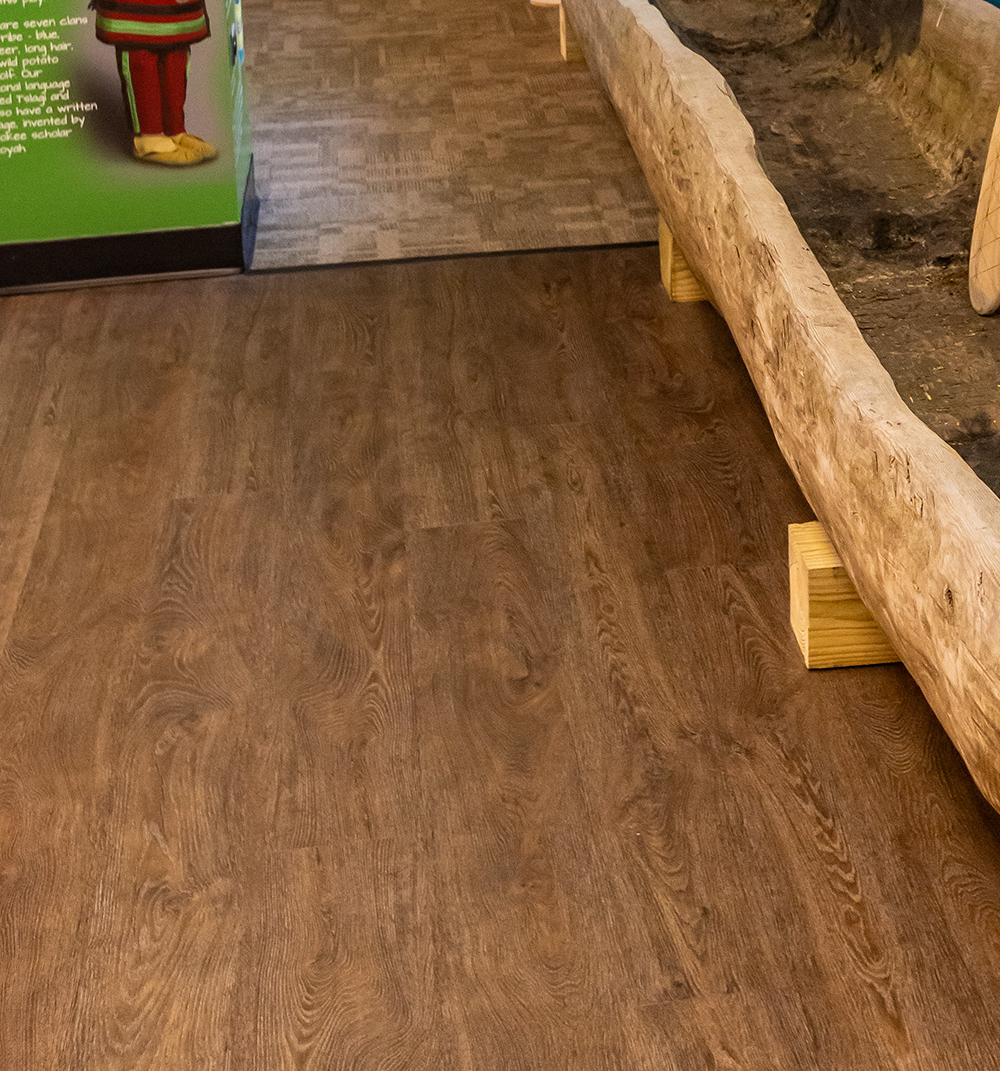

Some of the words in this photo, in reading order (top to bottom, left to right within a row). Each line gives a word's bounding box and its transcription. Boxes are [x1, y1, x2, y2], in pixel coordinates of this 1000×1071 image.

[23, 18, 56, 29] seven
[59, 15, 89, 27] clans
[24, 43, 47, 57] long
[22, 54, 59, 70] potato
[21, 68, 43, 79] Our
[25, 79, 71, 96] language
[50, 90, 70, 102] and
[16, 106, 42, 117] have
[46, 105, 53, 115] a
[57, 101, 98, 114] written
[22, 114, 68, 129] invented
[71, 113, 86, 129] by
[31, 128, 72, 141] scholar
